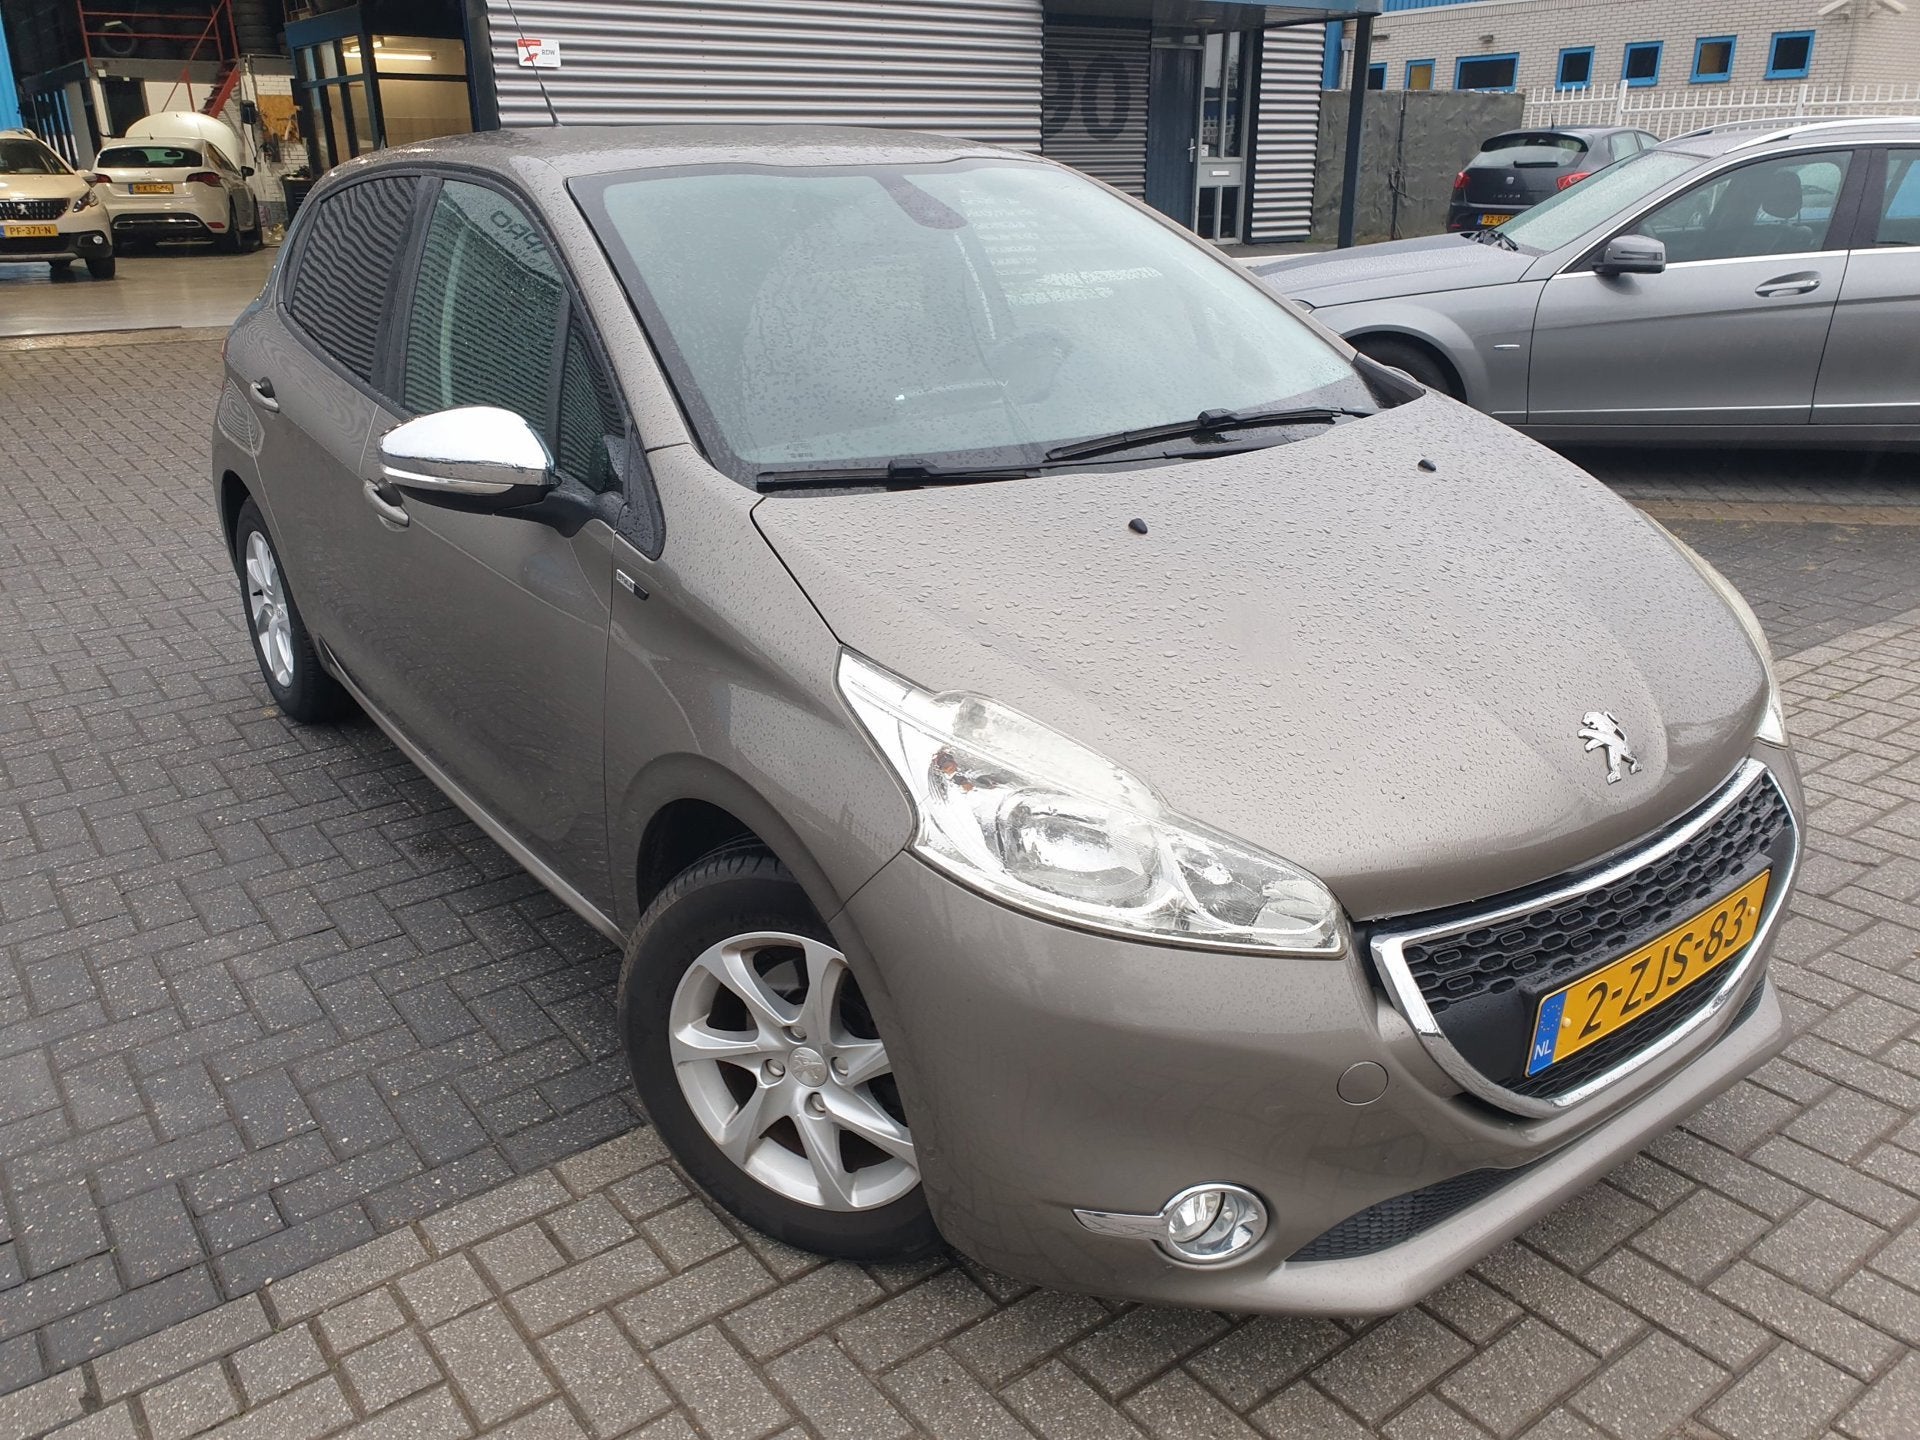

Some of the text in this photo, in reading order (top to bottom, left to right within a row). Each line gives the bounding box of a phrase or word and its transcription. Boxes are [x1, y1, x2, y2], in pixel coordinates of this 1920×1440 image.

[9, 226, 52, 236] PF-371-N
[1578, 896, 1748, 1040] 2-ZJS-83
[1534, 1039, 1552, 1060] NL
